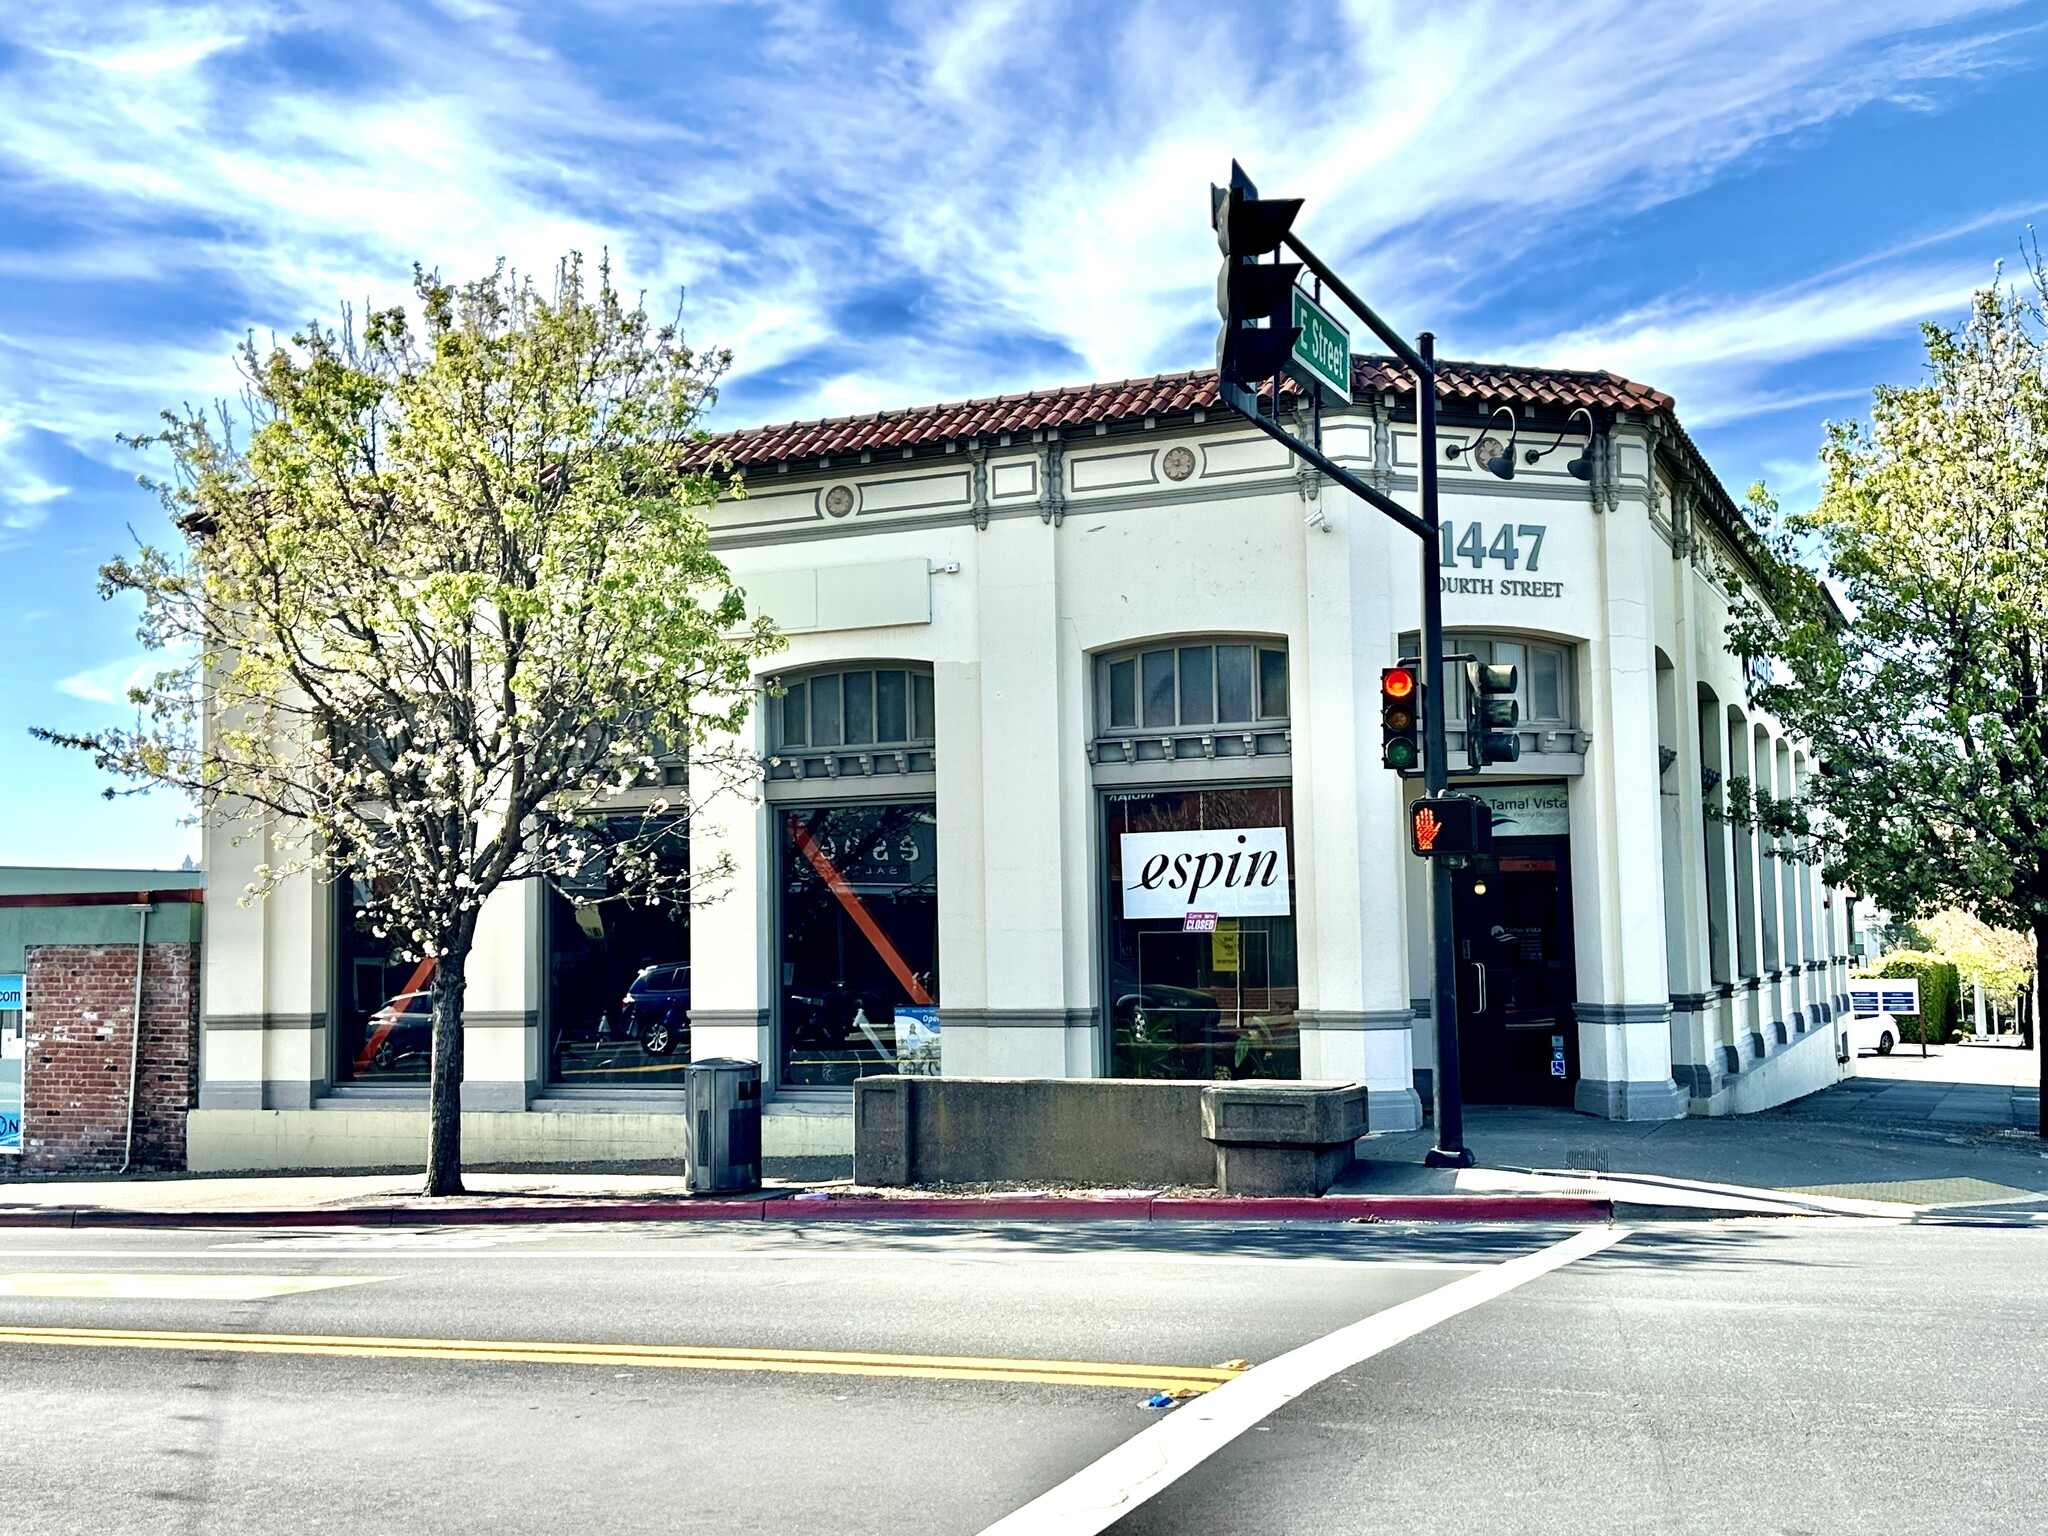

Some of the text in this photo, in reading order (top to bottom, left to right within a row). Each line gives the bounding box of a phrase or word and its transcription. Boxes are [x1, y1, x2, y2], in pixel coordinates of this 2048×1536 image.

[1300, 307, 1344, 379] E Street
[1439, 520, 1547, 572] 1447
[1440, 576, 1564, 598] OURTH STREET
[1489, 797, 1568, 810] Tamal Vista
[1126, 834, 1279, 905] espin
[1185, 919, 1215, 931] CLOSED
